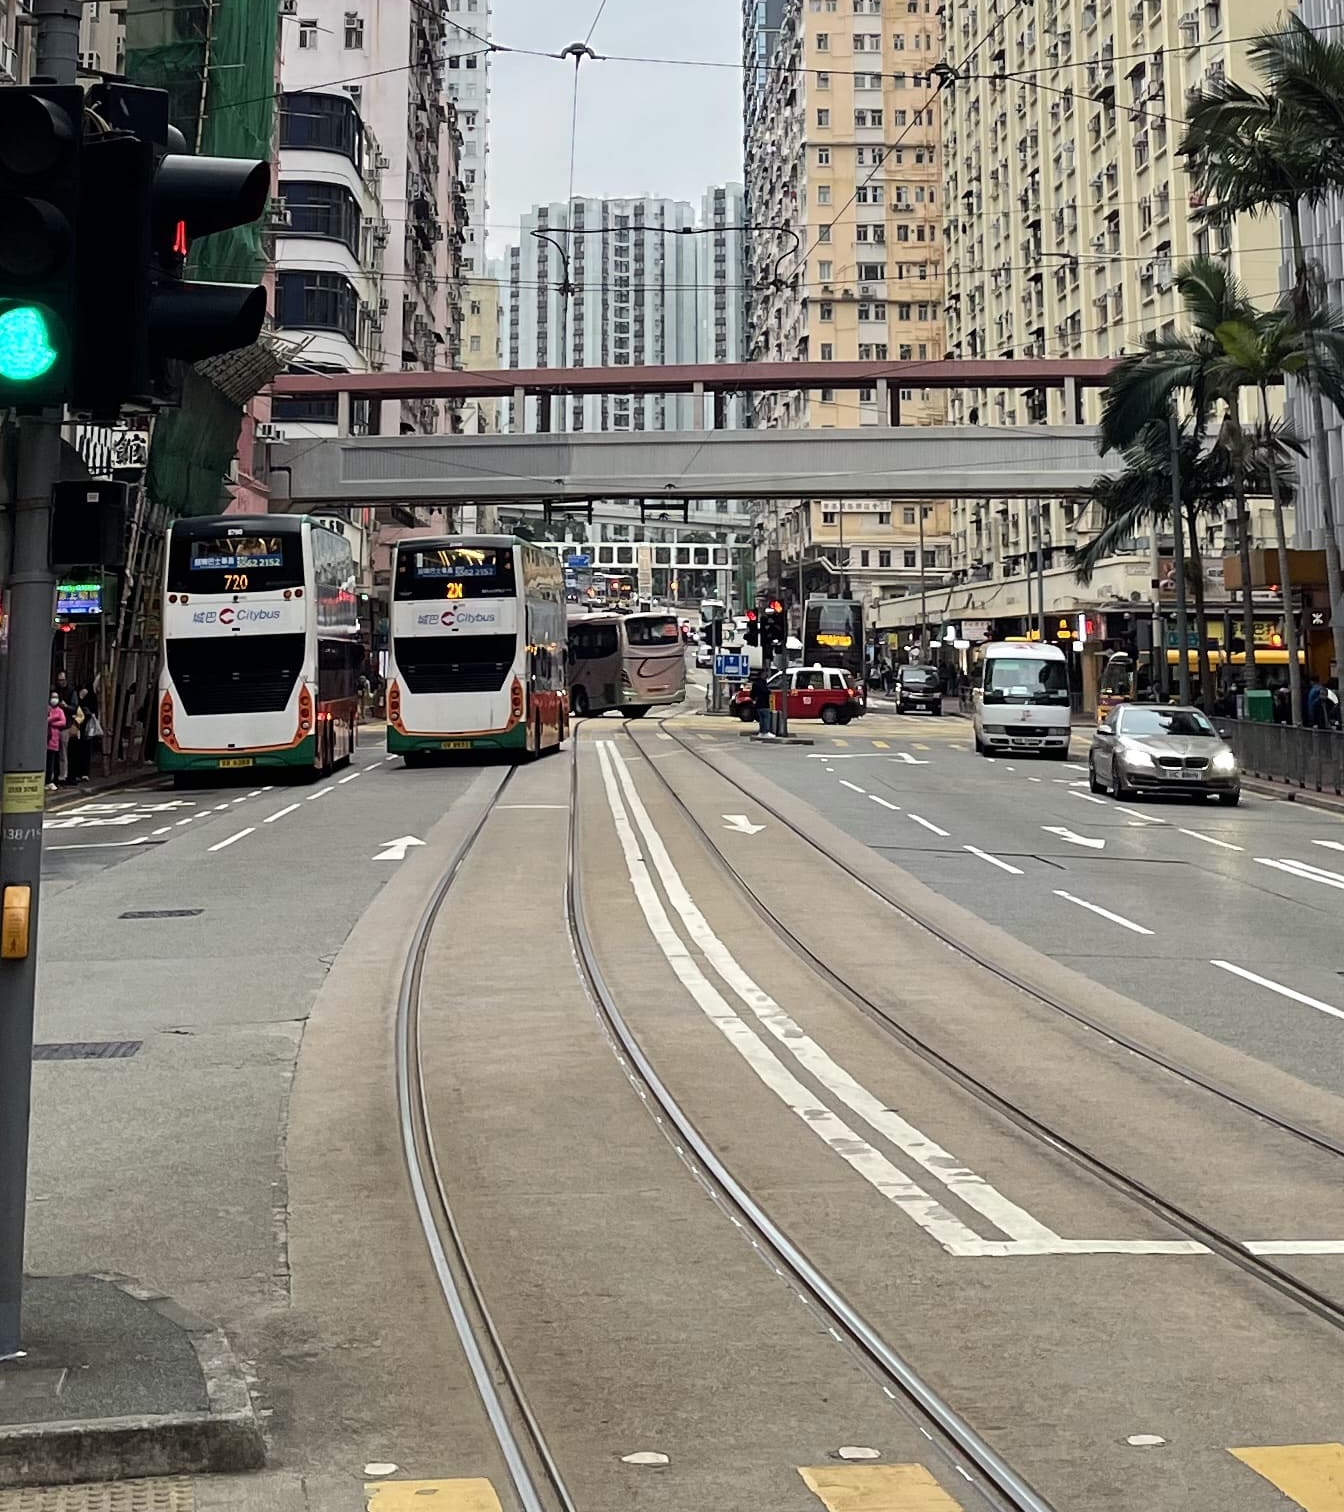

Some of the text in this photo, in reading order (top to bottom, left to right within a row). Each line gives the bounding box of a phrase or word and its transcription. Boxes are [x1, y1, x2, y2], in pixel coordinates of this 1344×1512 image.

[224, 574, 248, 591] 720
[236, 609, 281, 622] Citybus
[456, 610, 496, 624] Citybus
